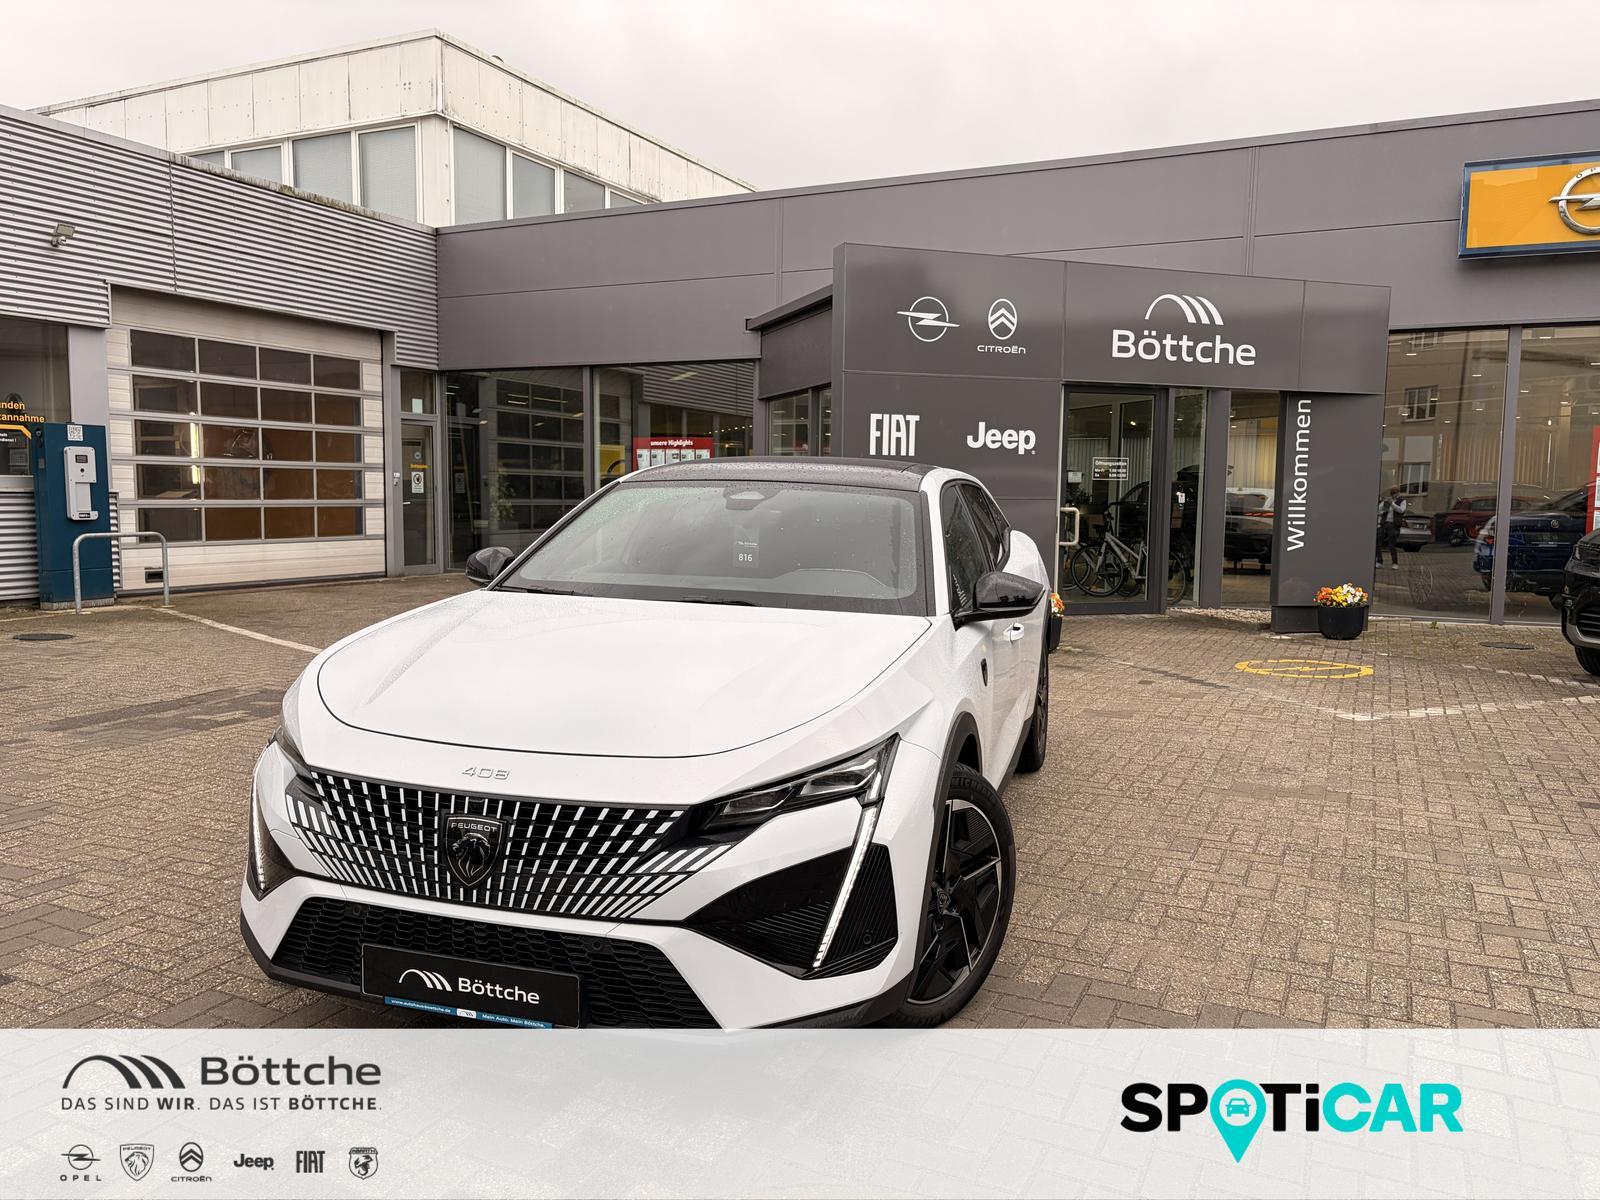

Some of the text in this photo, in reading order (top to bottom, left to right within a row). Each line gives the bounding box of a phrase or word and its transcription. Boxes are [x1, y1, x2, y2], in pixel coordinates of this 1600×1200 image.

[1112, 329, 1257, 366] Böttche
[869, 413, 920, 457] FIAT
[668, 439, 694, 448] Highlights
[1287, 399, 1312, 552] Willkommen
[738, 553, 753, 562] 816
[461, 766, 511, 780] 408
[451, 822, 498, 833] PEUGEOT
[458, 977, 541, 1005] Böttche
[481, 1013, 495, 1021] Mein
